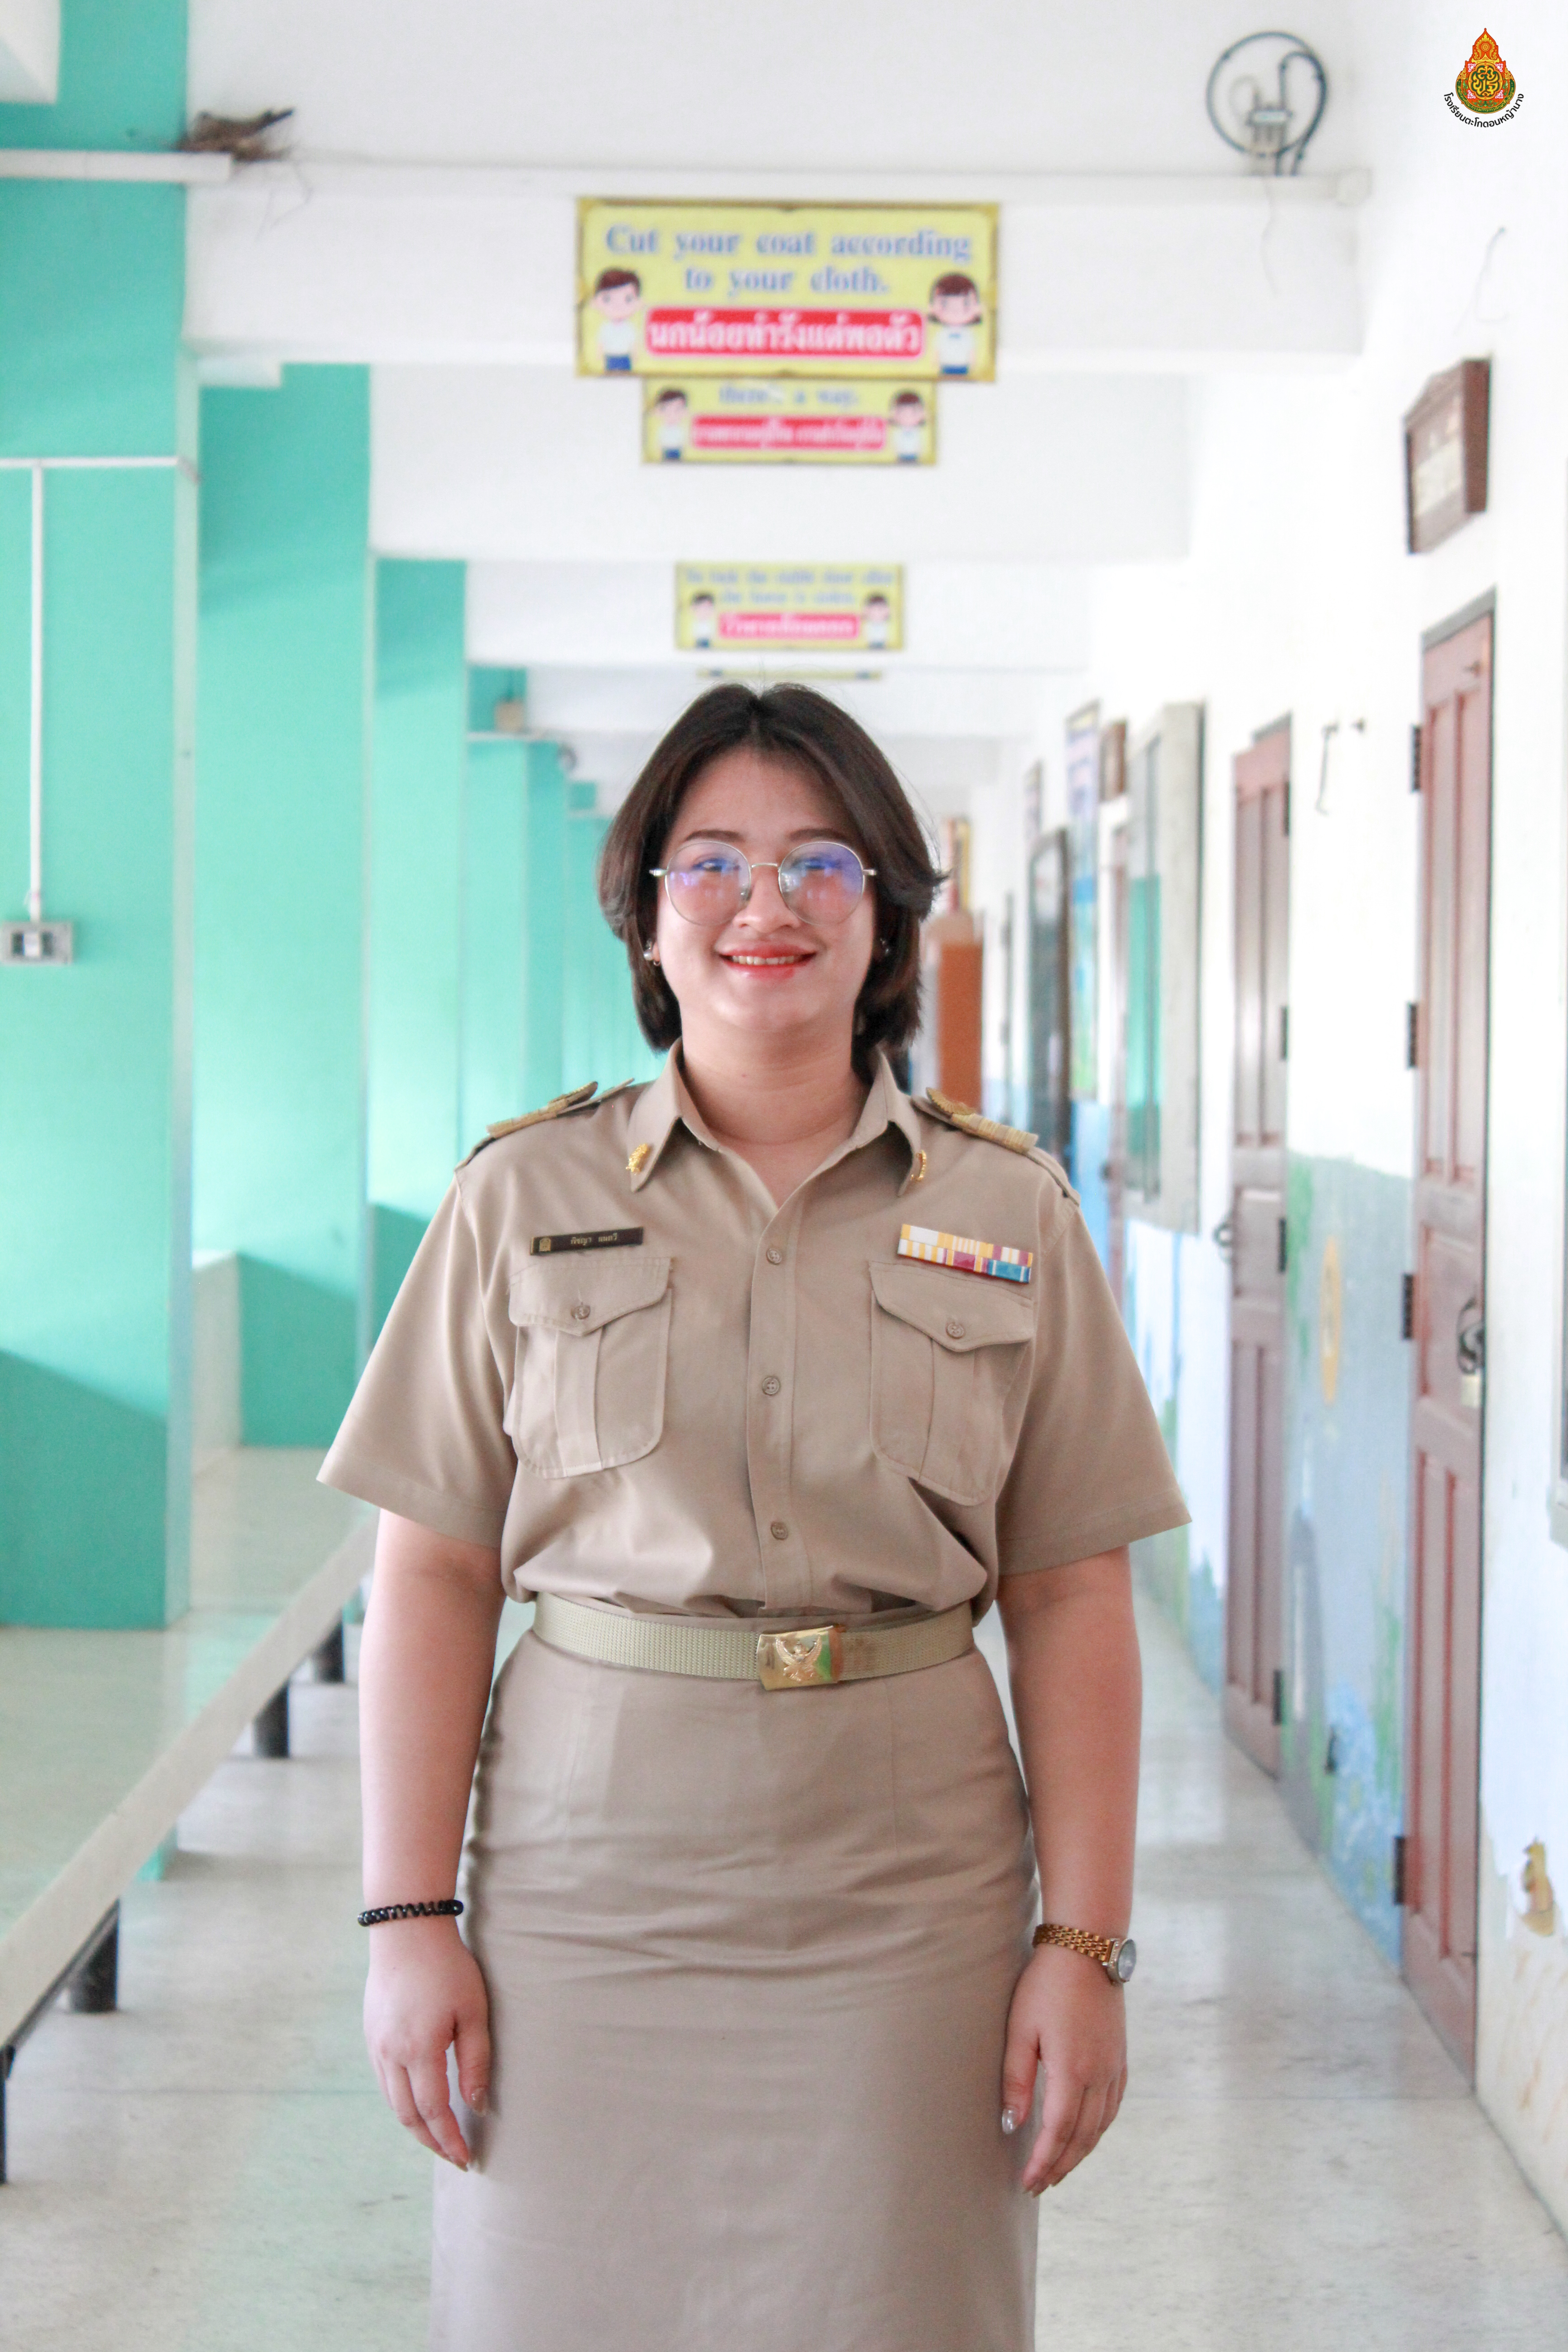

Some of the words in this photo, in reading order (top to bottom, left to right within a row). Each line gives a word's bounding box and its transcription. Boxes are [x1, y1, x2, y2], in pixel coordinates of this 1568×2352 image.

[606, 225, 657, 253] Cut
[674, 233, 740, 260] your
[756, 230, 815, 255] coat
[831, 230, 971, 263] according
[685, 266, 712, 291] to
[729, 270, 794, 296] your
[811, 266, 888, 294] cloth.
[649, 309, 919, 351] นกน้อยทำรังแต่พอตัว
